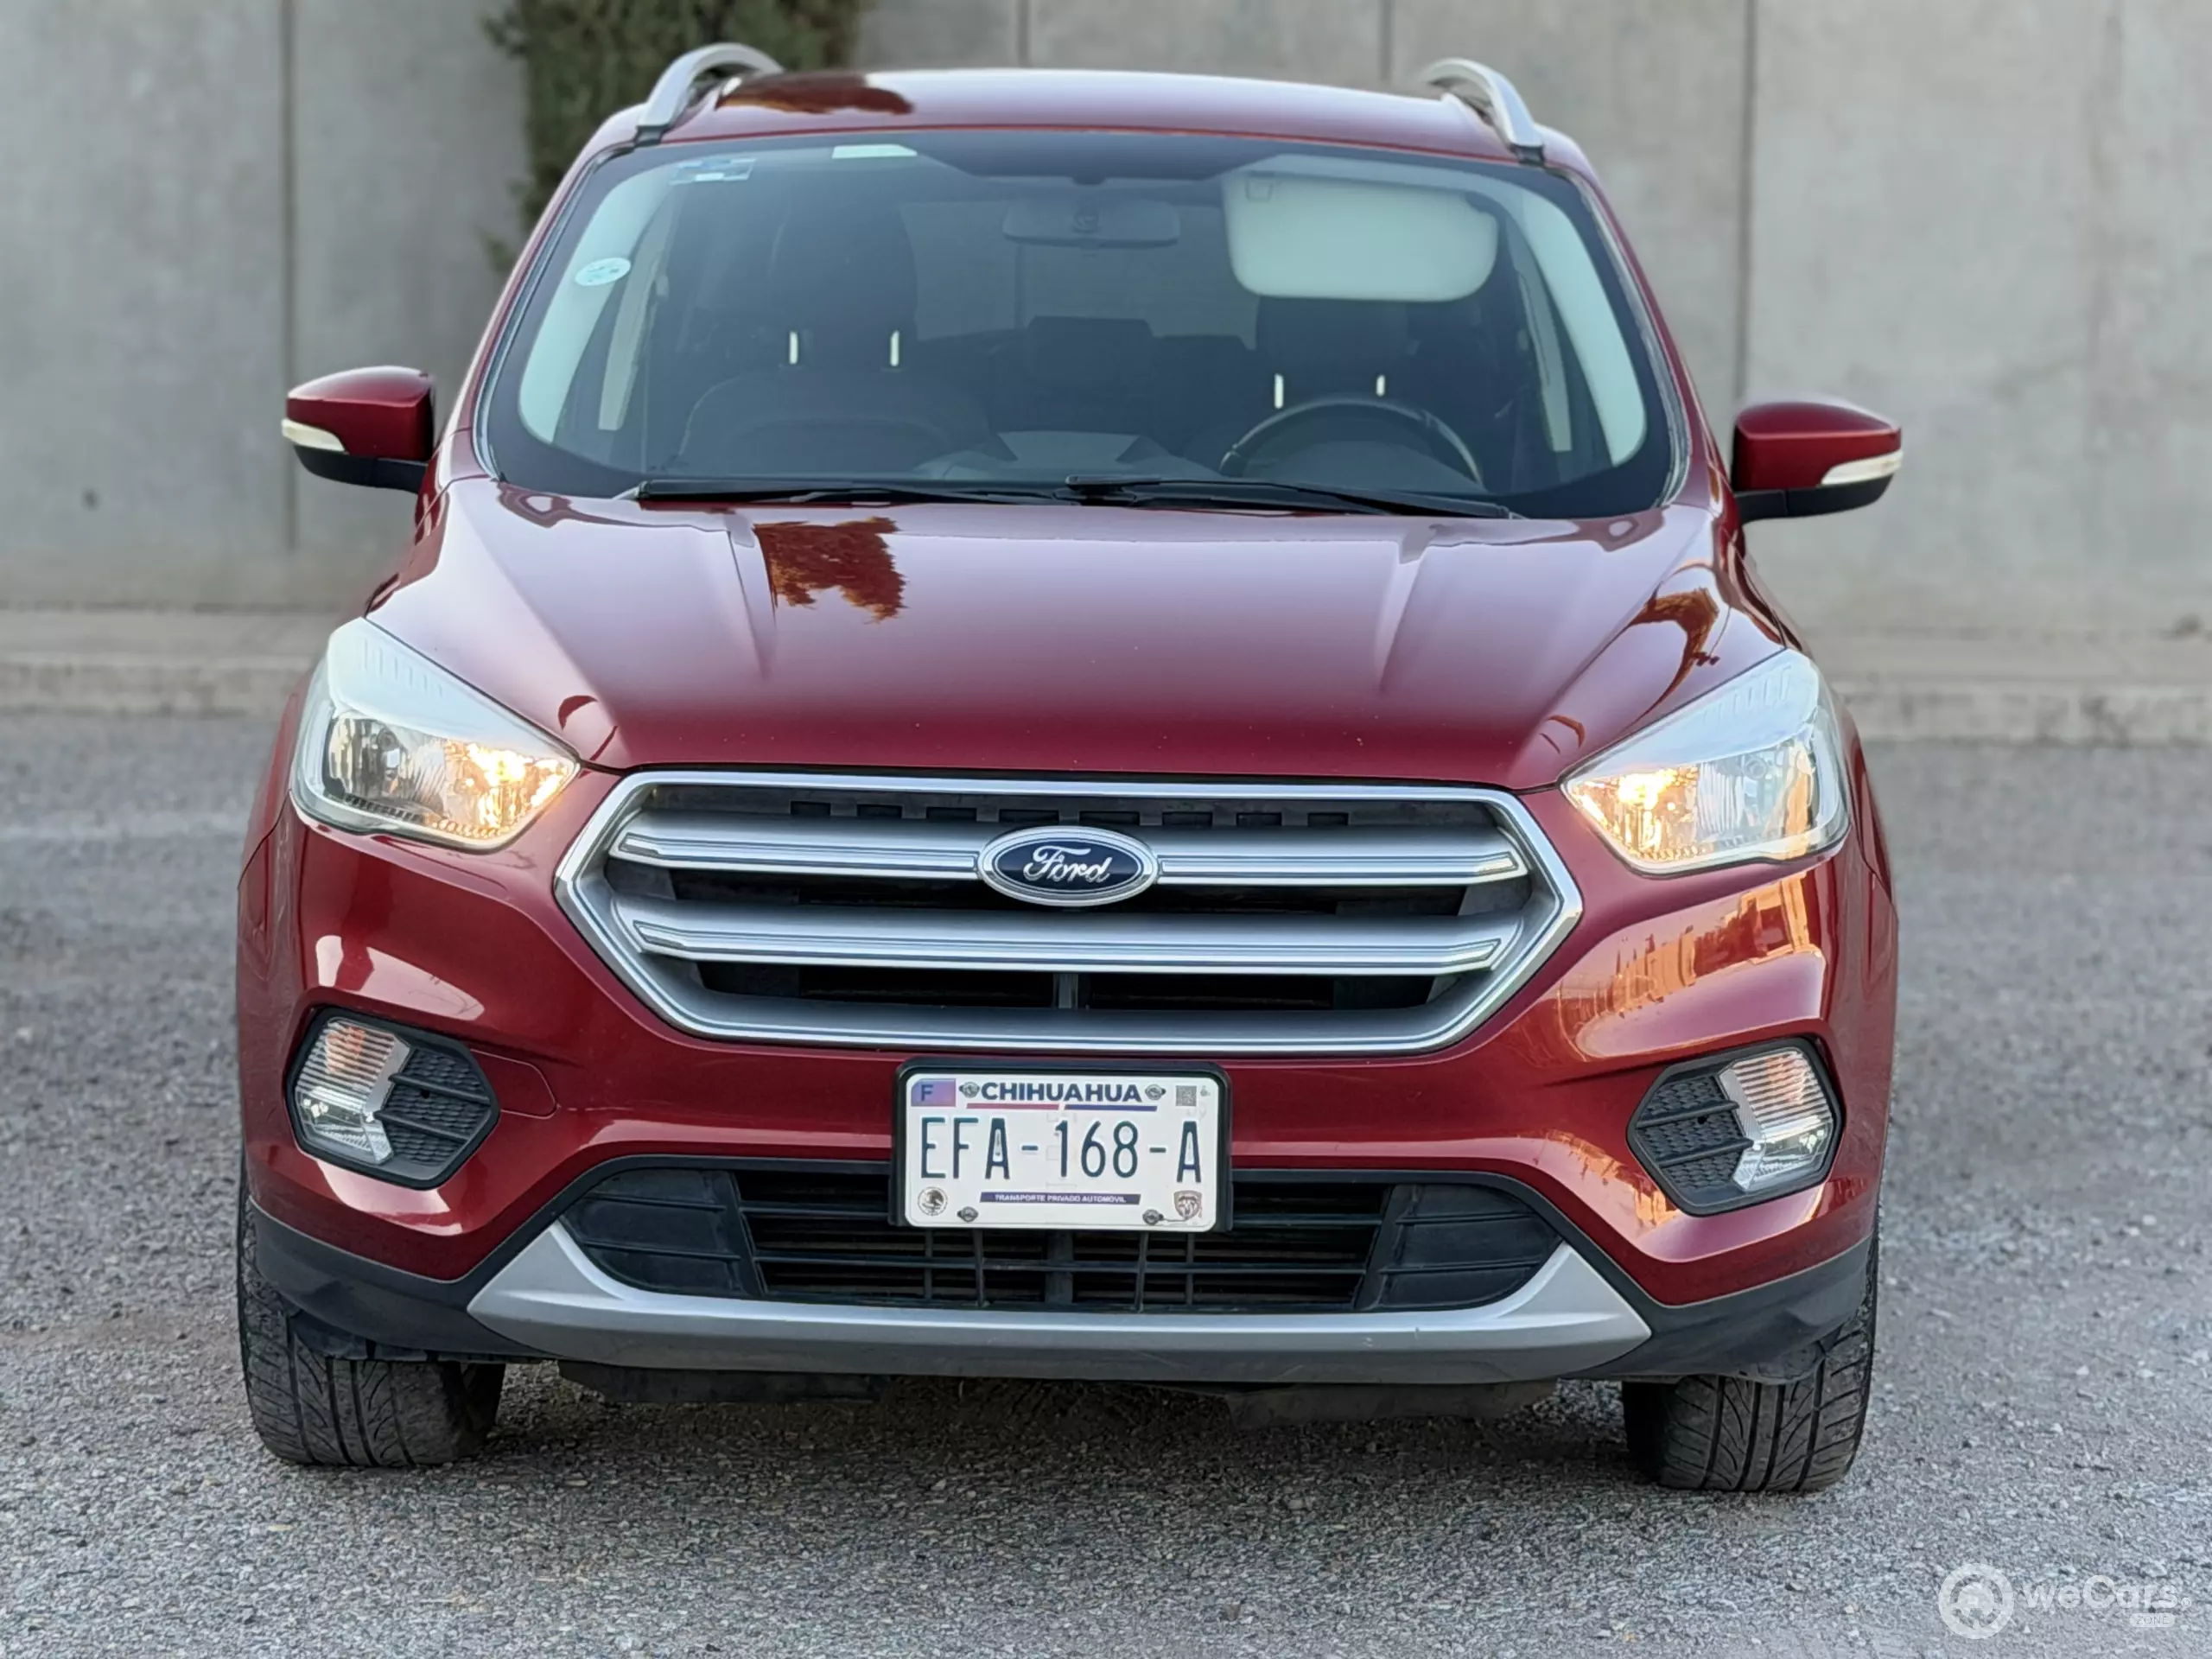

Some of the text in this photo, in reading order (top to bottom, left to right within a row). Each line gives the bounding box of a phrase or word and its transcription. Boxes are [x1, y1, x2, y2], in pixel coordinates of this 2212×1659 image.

[1023, 845, 1113, 882] Ford
[981, 1082, 1142, 1103] CHIHUAHUA
[920, 1116, 1202, 1183] EFA-168-A
[995, 1193, 1046, 1202] TRANSPORTE
[1047, 1194, 1081, 1203] PRIVADO
